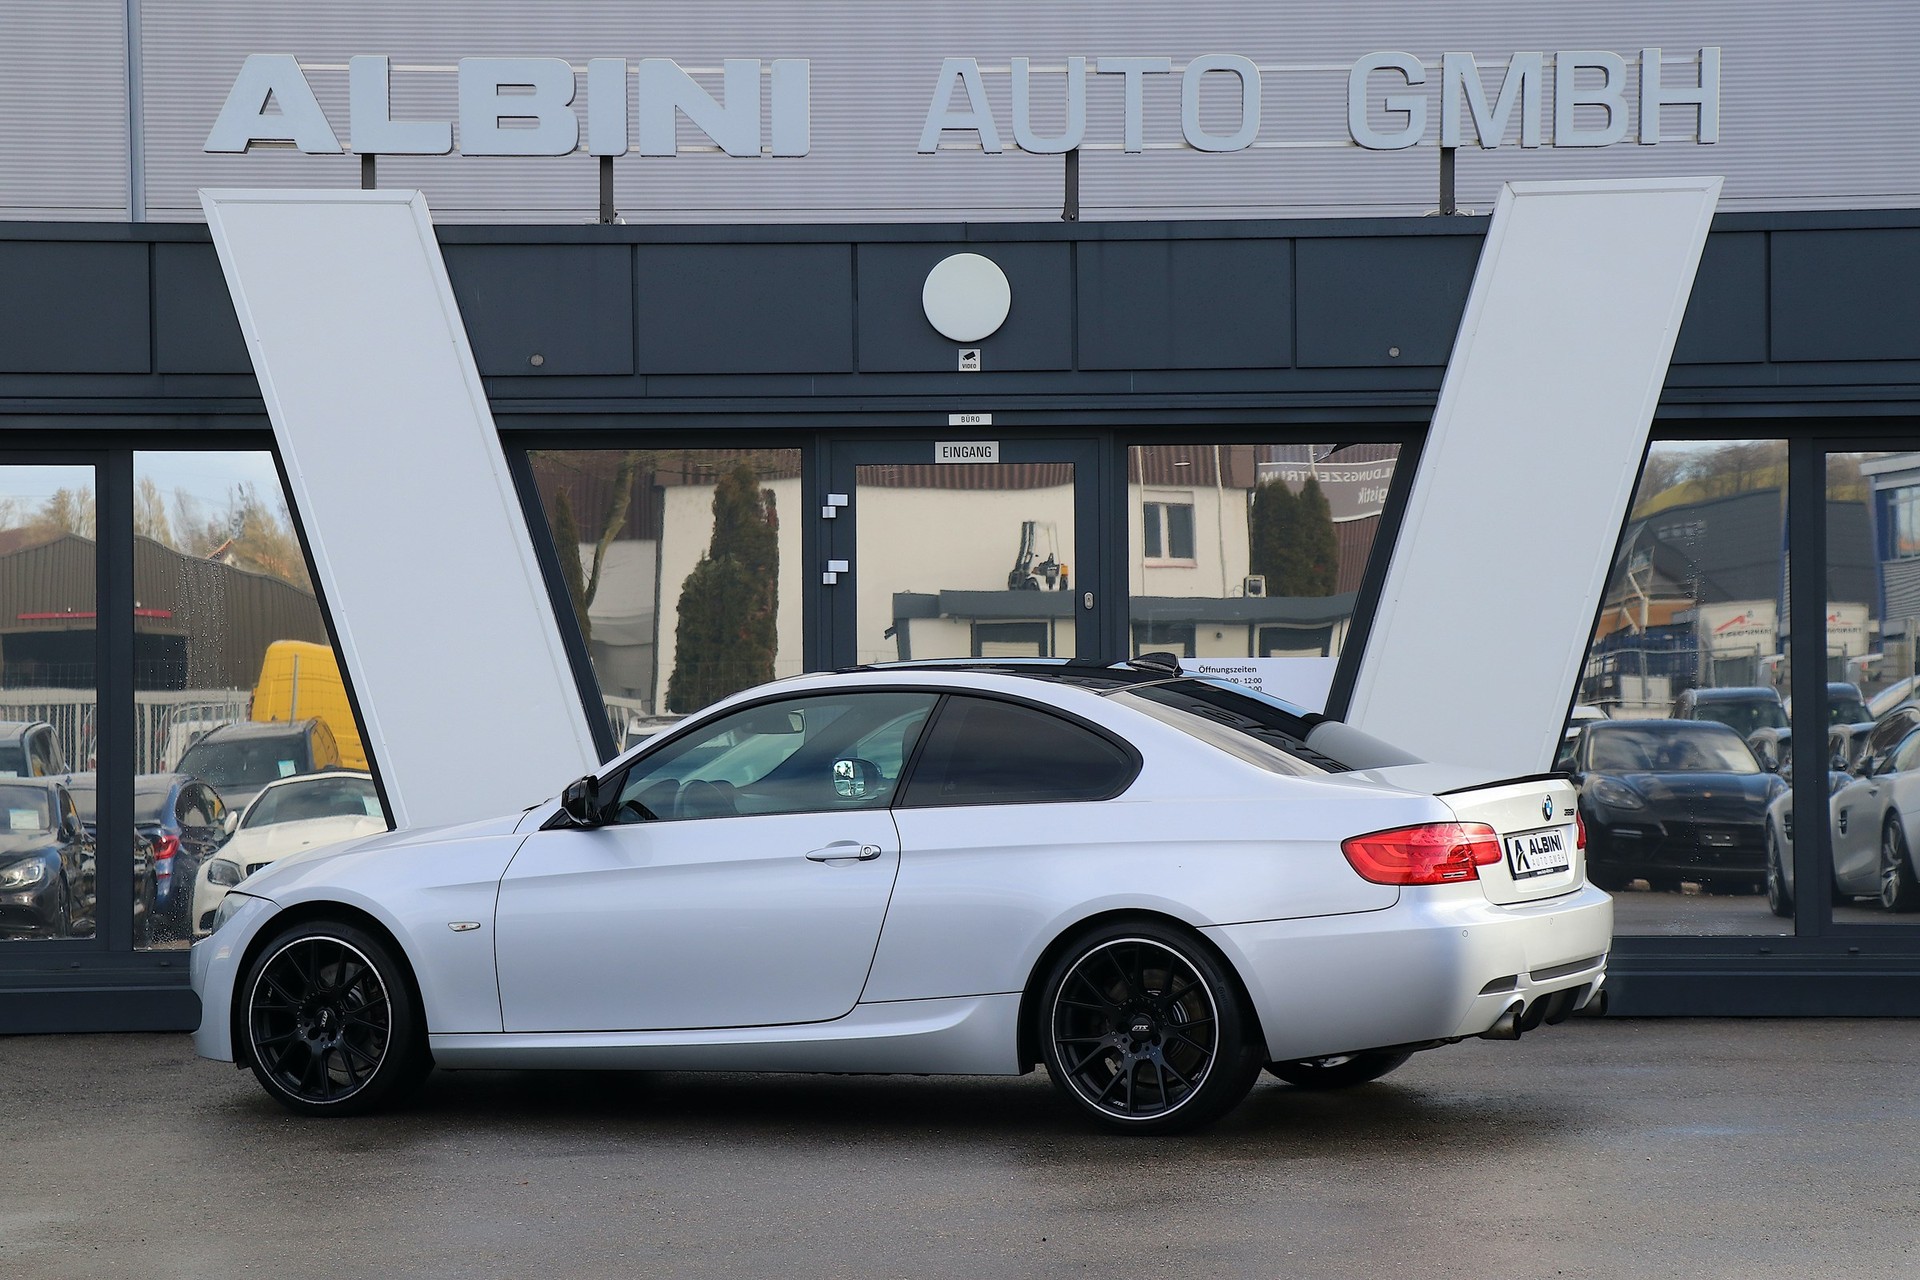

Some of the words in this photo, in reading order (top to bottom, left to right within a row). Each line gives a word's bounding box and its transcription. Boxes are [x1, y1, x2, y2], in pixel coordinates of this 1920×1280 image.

[203, 53, 811, 157] ALBINI
[916, 54, 1262, 155] AUTO
[1347, 46, 1722, 152] GMBH
[960, 414, 980, 423] BÜRO
[942, 446, 992, 458] EINGANG
[1198, 665, 1257, 674] Öffnungszeiten
[1529, 834, 1562, 855] ALBINI
